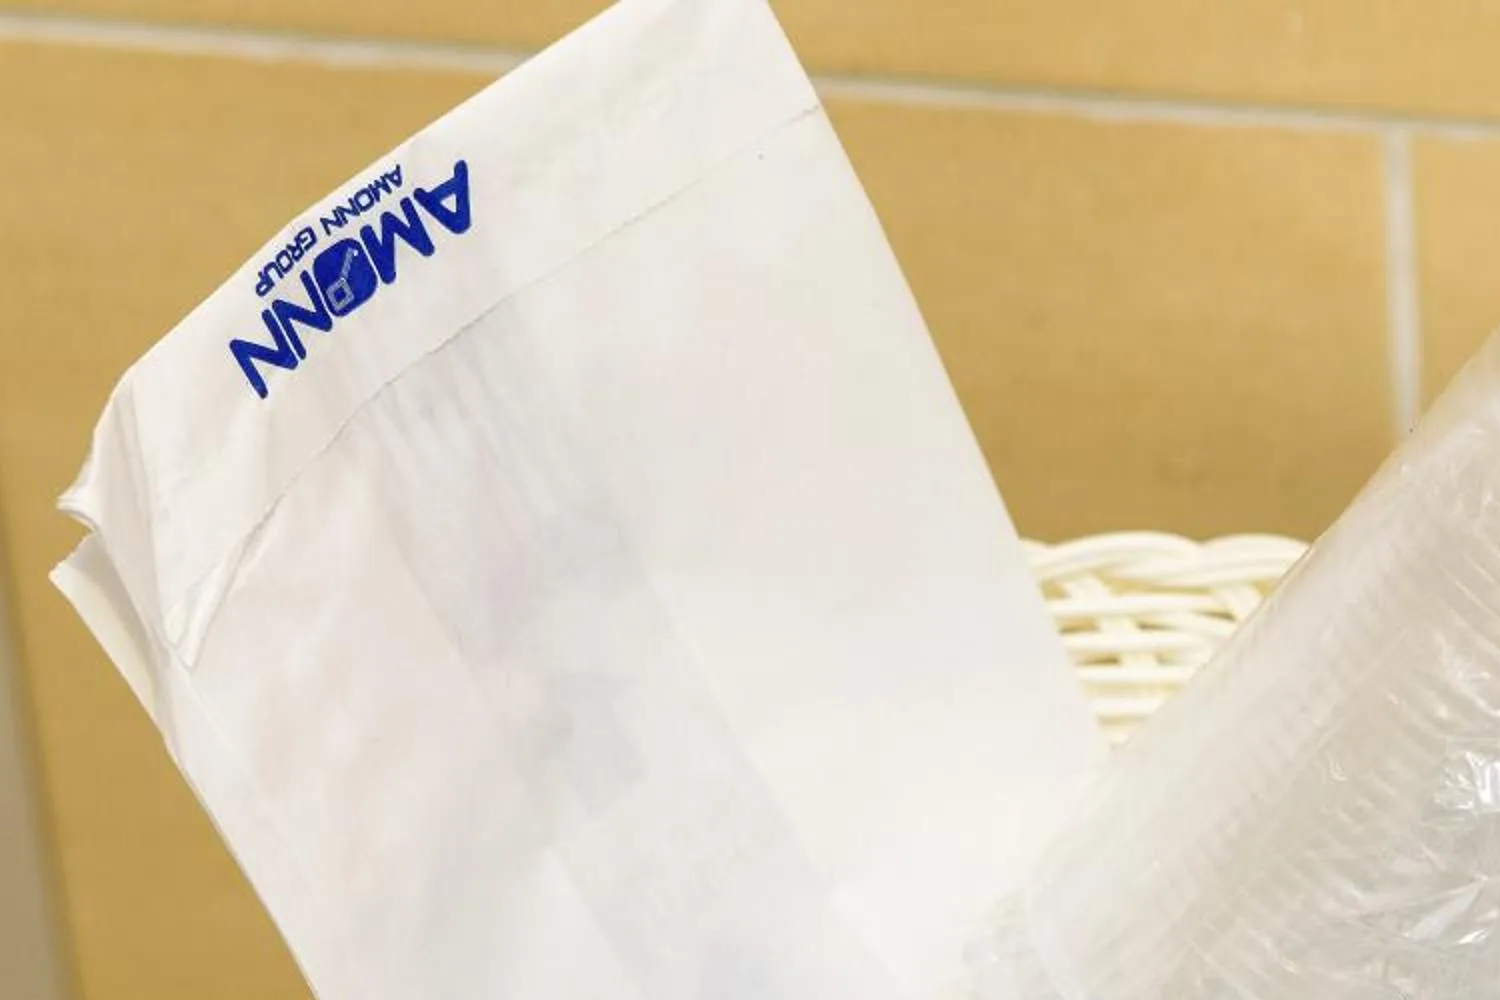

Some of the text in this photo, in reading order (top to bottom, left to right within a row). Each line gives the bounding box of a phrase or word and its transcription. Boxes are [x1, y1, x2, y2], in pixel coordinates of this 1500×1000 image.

[230, 160, 471, 399] AMONN
[255, 164, 402, 297] AMONN GROUP
